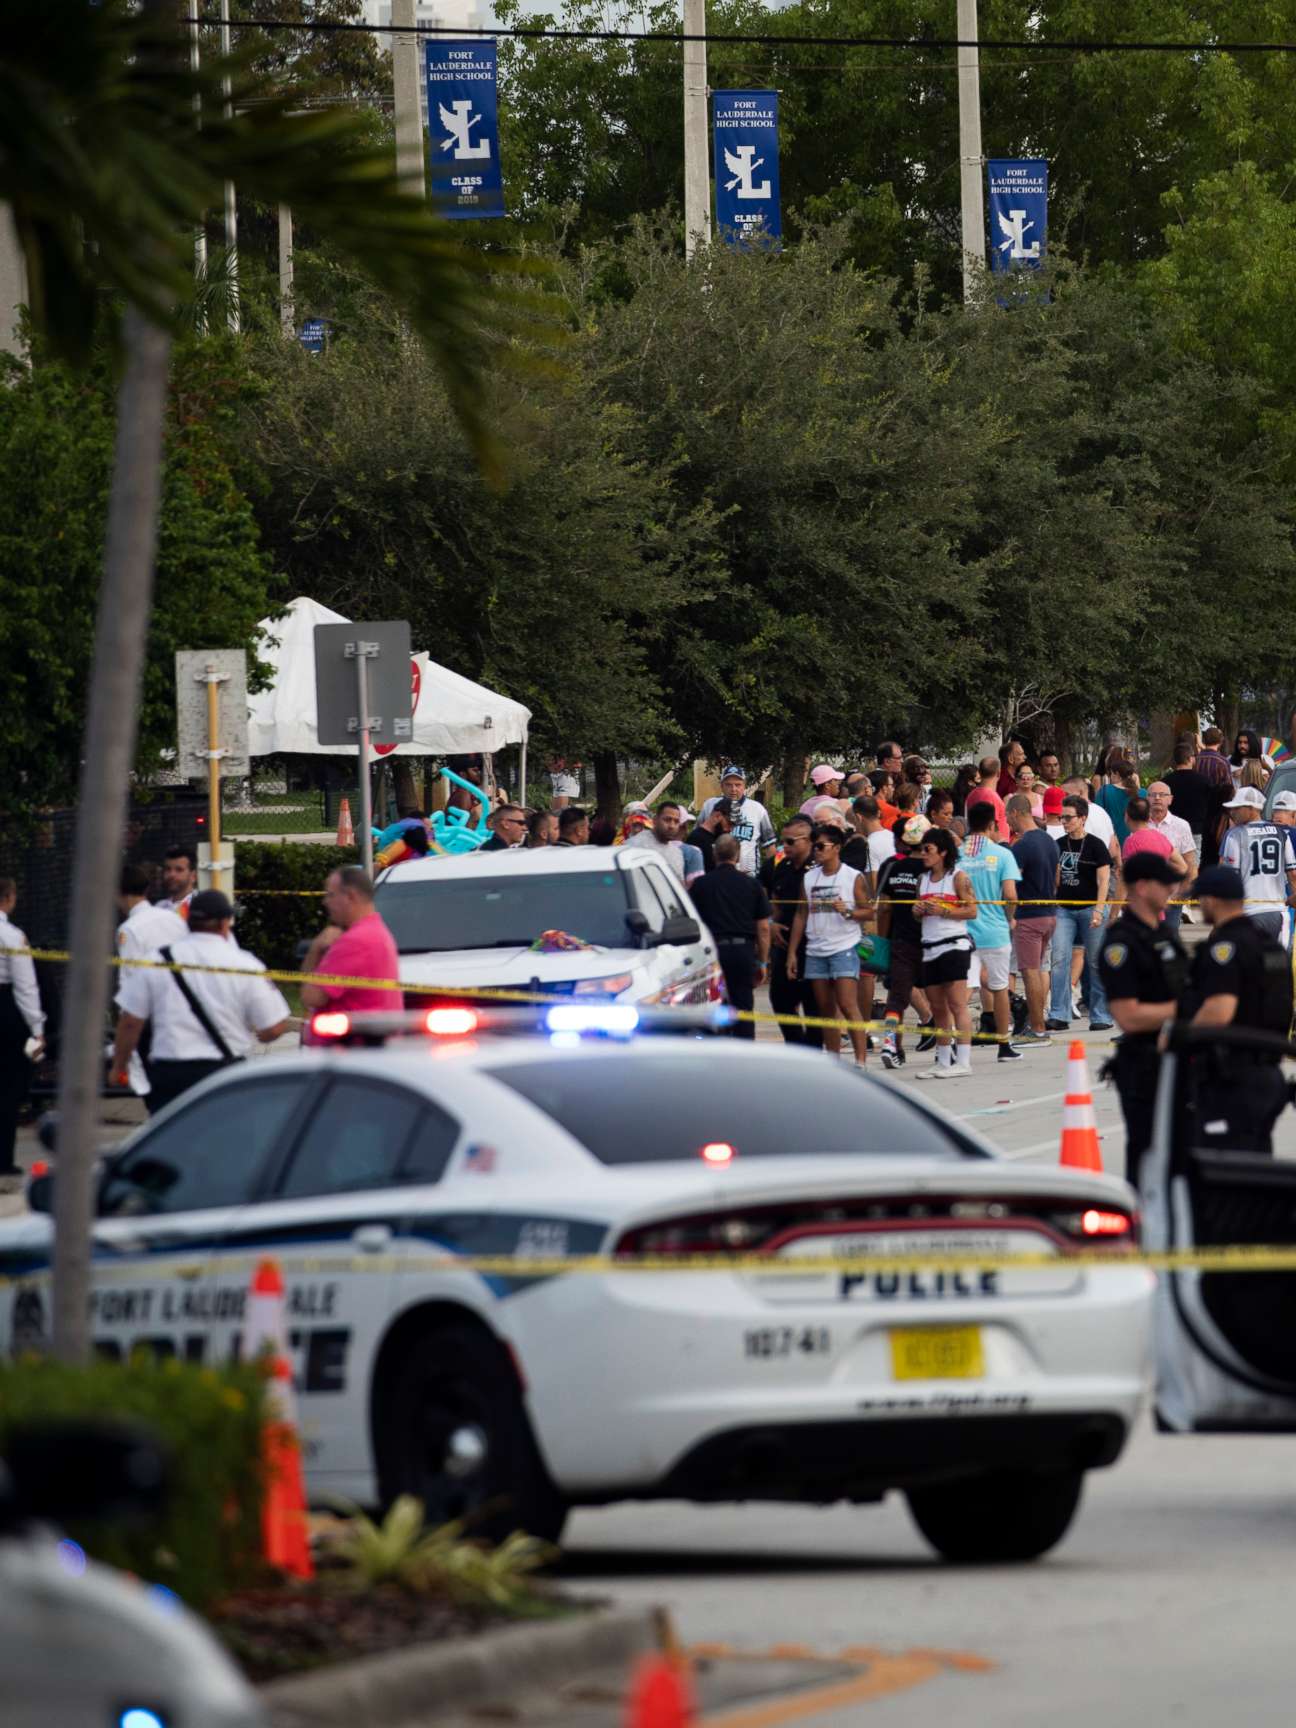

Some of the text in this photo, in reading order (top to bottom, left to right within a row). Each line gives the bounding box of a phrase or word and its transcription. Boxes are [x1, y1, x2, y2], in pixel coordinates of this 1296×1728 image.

[448, 51, 474, 60] FORT
[430, 61, 493, 71] LAUDERDALE
[429, 72, 494, 81] HIGH SCHOOL
[734, 101, 757, 109] FORT
[716, 110, 774, 119] LAUDERDALE
[716, 120, 776, 128] HIGH SCHOOL
[1006, 169, 1028, 177] FORT
[451, 176, 483, 186] CLASS
[991, 178, 1044, 186] LAUDERDALE
[461, 186, 474, 195] OF
[1248, 838, 1281, 877] 19
